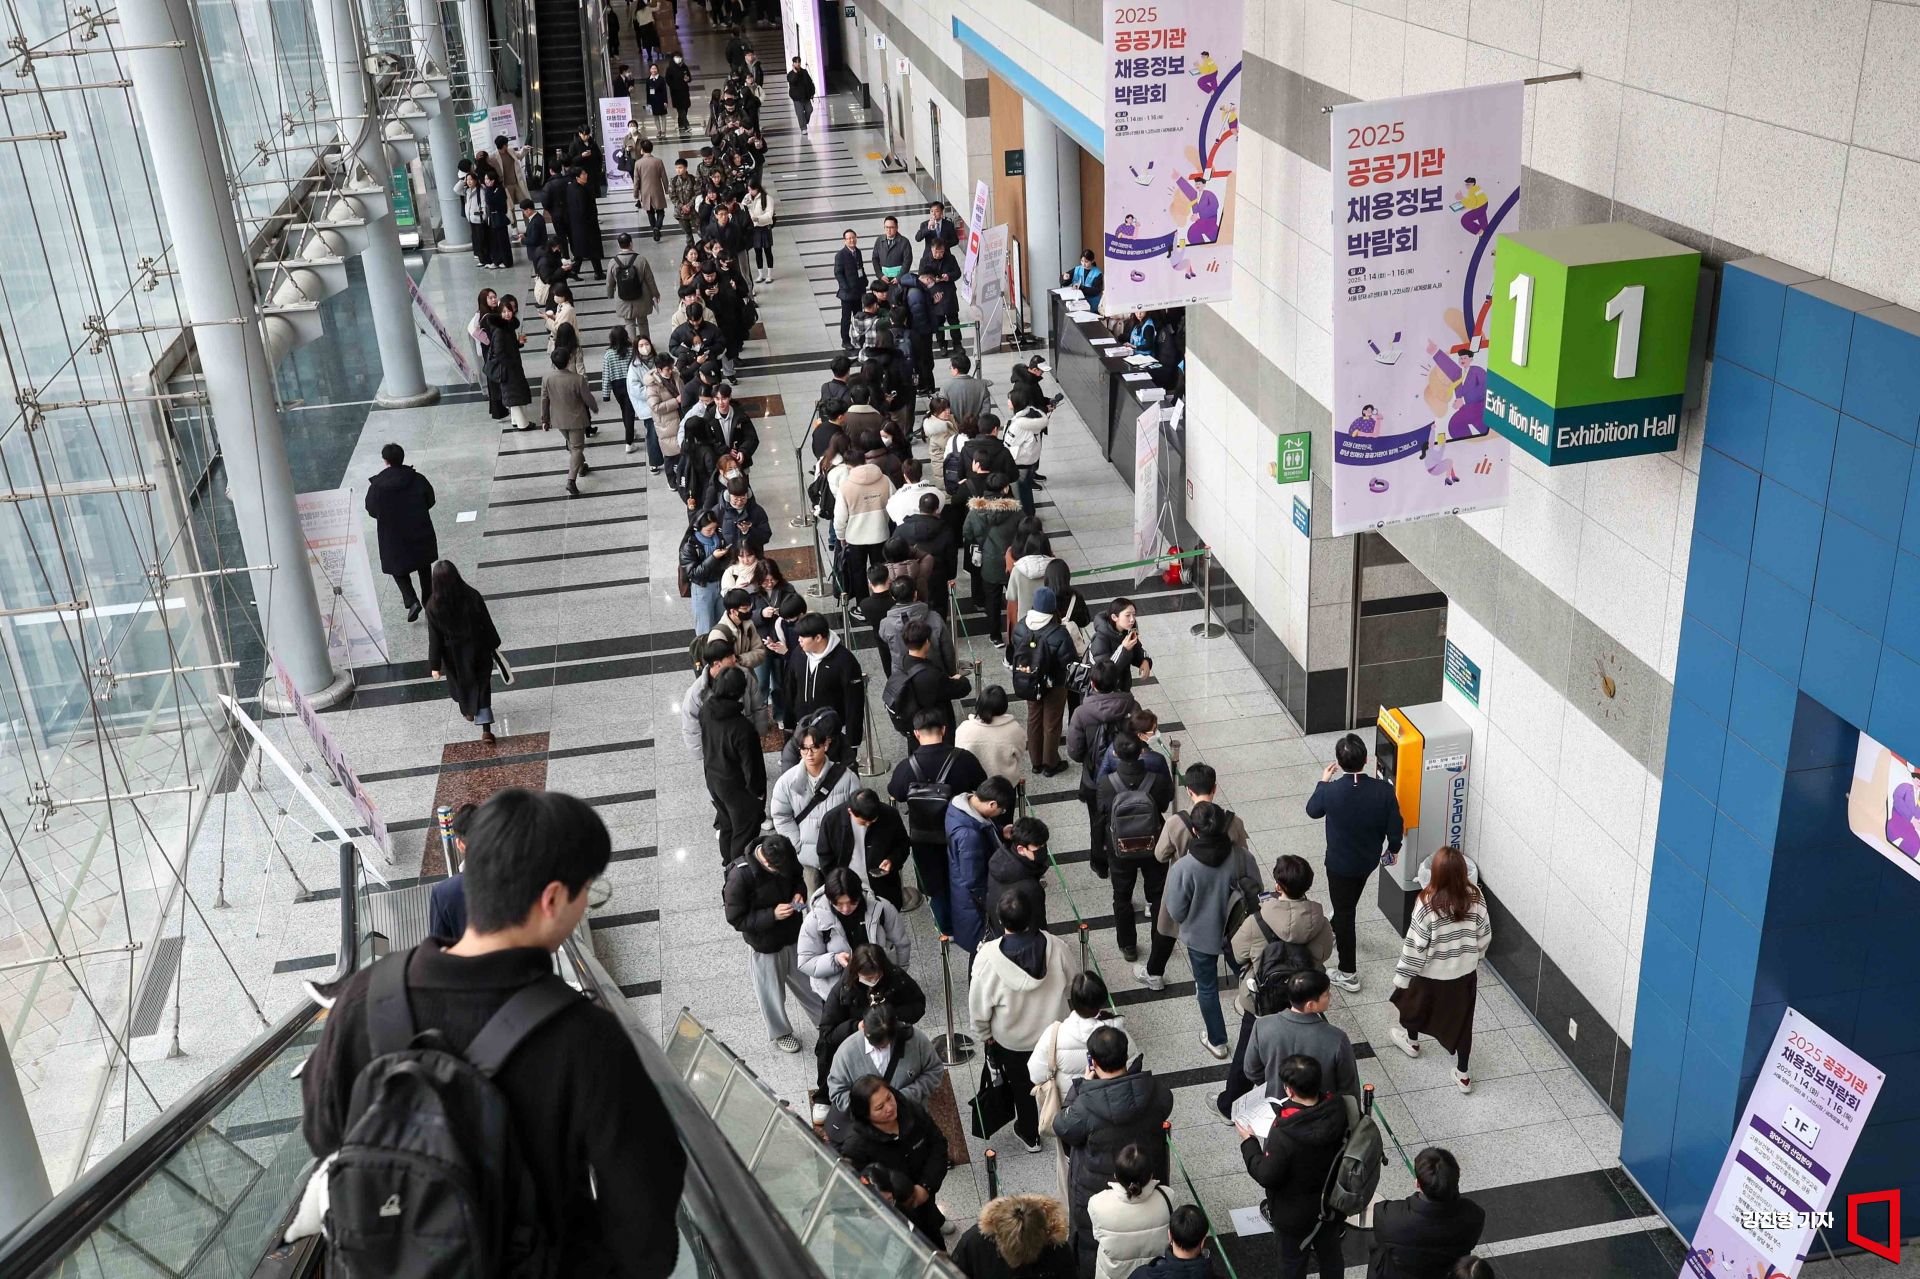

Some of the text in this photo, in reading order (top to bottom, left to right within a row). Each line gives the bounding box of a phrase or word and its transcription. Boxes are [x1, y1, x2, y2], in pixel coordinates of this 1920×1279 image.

[1114, 7, 1157, 24] 2025
[1115, 28, 1187, 52] 공공기관
[1115, 56, 1185, 78] 채용정보
[1115, 83, 1166, 105] 박람회
[1348, 122, 1405, 149] 2025
[1348, 147, 1445, 187] 공공기관
[1347, 186, 1443, 223] 채용정보
[1348, 225, 1417, 258] 박람회
[1509, 273, 1534, 367] 1
[1606, 285, 1645, 379] 1
[1529, 416, 1550, 446] Hall
[1557, 414, 1676, 449] Exhibition Hall
[1452, 778, 1464, 823] GUARD
[1776, 1062, 1791, 1076] 2025.
[1788, 1030, 1867, 1094] 2025 공공기관
[1782, 1047, 1860, 1110] 채용정보박람회
[1794, 1117, 1808, 1132] 1F
[1790, 1148, 1812, 1168] 산업분야
[1765, 1175, 1787, 1196] 부대시설
